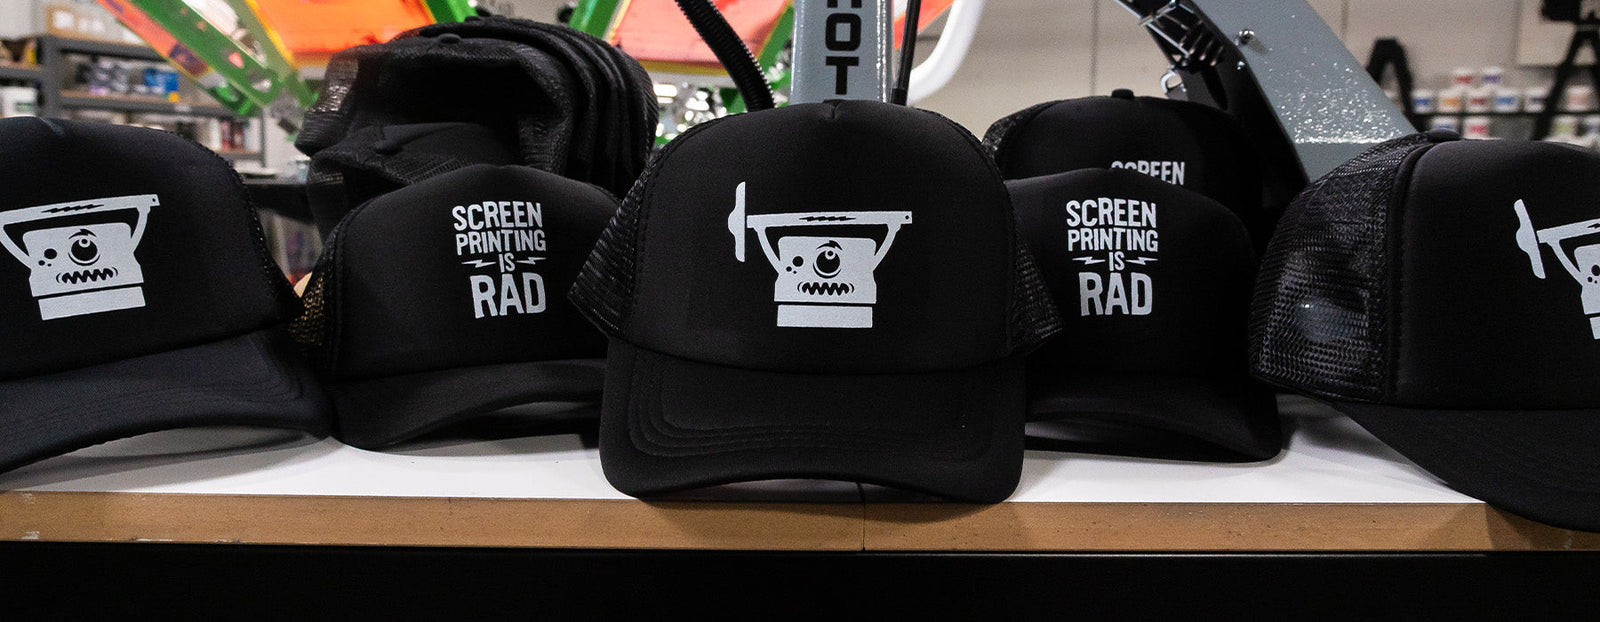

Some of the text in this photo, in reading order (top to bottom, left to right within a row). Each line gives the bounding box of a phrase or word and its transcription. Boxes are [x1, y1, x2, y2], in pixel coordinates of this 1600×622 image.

[825, 0, 862, 95] OT
[1111, 160, 1185, 186] REEN
[451, 201, 543, 231] SCREEN
[1066, 197, 1157, 228] SCREEN
[455, 229, 546, 256] PRINTING
[1067, 227, 1159, 252] PRINTING
[498, 252, 516, 273] IS
[1108, 251, 1126, 272] IS
[469, 272, 547, 319] RAD
[1078, 271, 1154, 317] RAD
